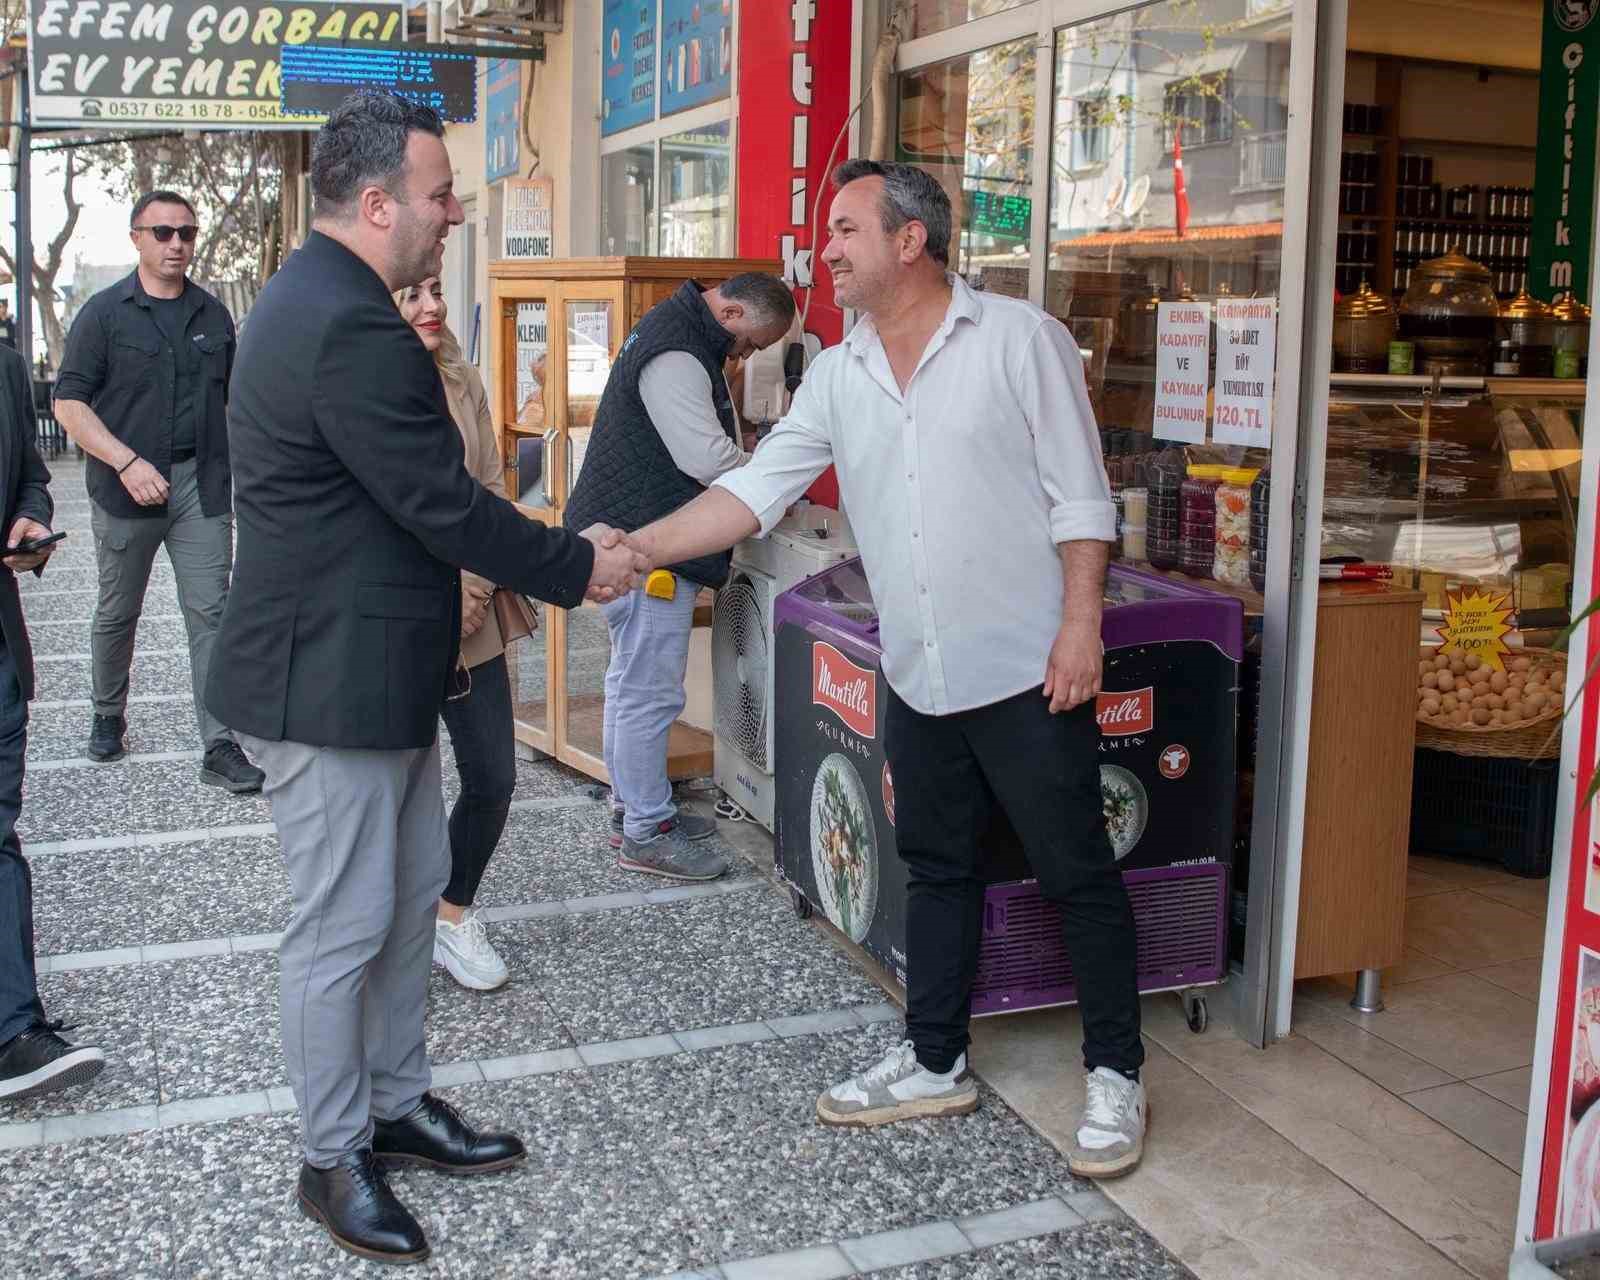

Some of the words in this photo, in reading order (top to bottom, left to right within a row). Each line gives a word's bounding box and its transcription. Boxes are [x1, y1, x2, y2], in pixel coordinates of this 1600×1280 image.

[36, 0, 174, 42] EFEM
[39, 53, 109, 93] EV
[109, 103, 148, 116] 0537
[155, 104, 183, 117] 622
[191, 104, 208, 118] 18
[215, 105, 233, 118] 78
[1555, 42, 1584, 246] Çiftlik
[506, 237, 550, 256] VODAFONE
[1169, 311, 1205, 324] EKMEK
[1219, 304, 1272, 320] KAMPANYA
[1159, 333, 1207, 348] KADAYIFI
[1241, 330, 1260, 346] ADET
[1176, 357, 1190, 371] VE
[1235, 352, 1250, 371] KÖY
[1161, 380, 1204, 397] KAYMAK
[1222, 379, 1264, 398] YUMURTASI
[1156, 405, 1205, 423] BULUNUR
[818, 656, 868, 717] Mantilla
